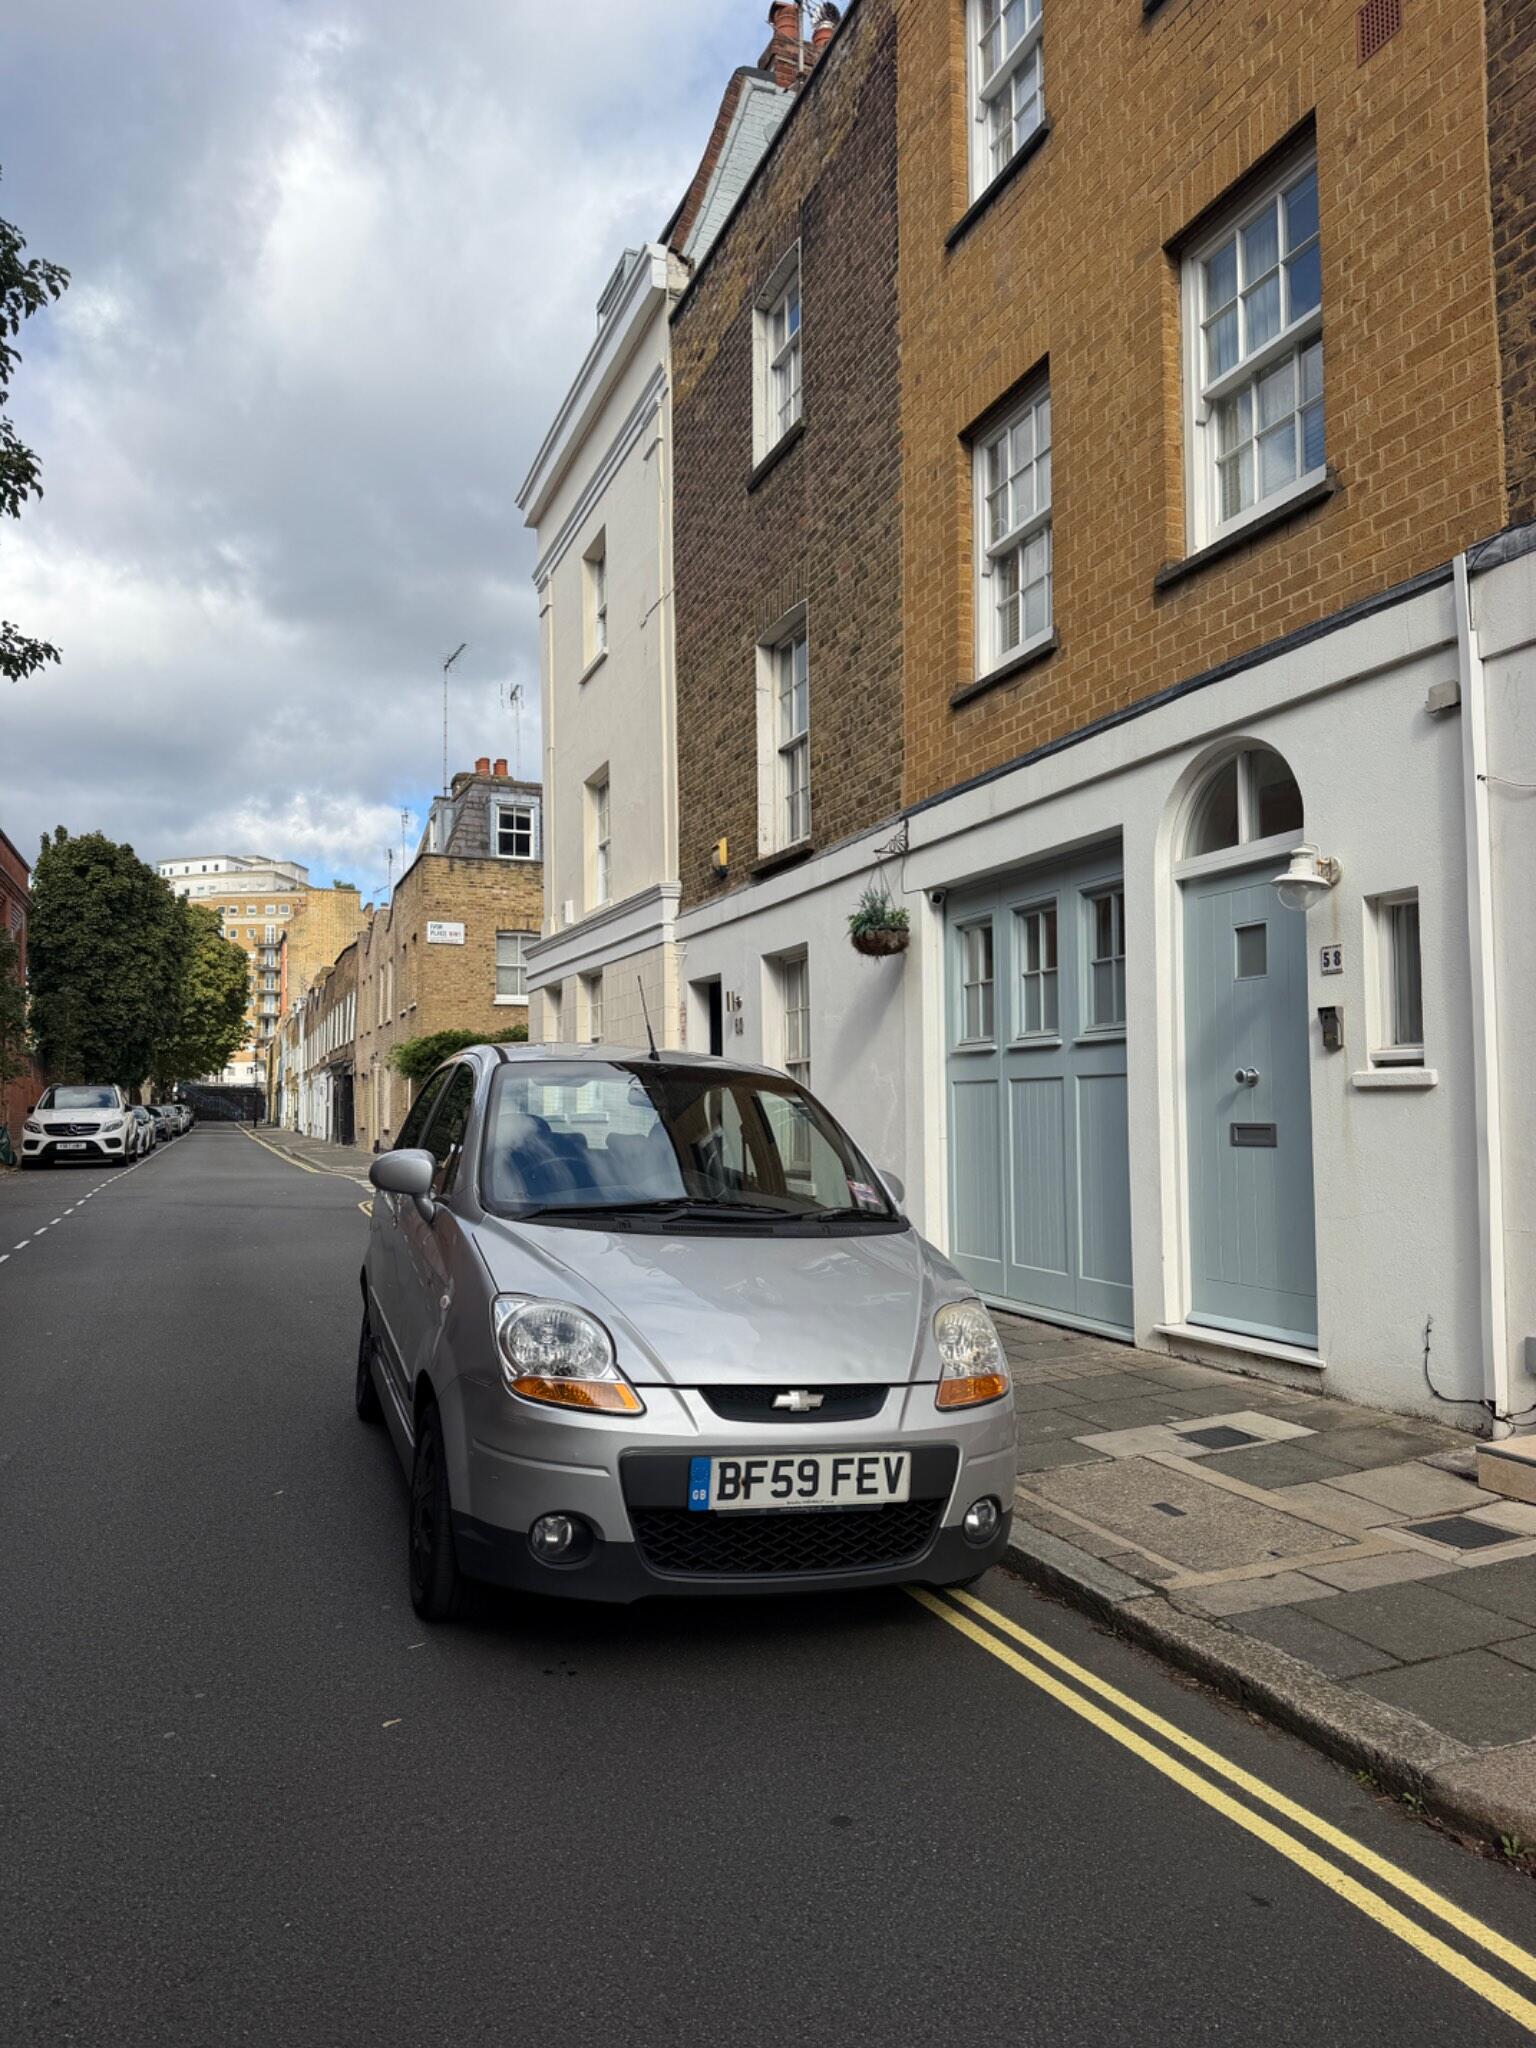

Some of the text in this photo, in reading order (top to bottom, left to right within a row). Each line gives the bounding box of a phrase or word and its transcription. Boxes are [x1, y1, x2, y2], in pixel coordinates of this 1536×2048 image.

[1323, 951, 1342, 968] 58
[717, 1456, 904, 1500] BF59 FEV
[692, 1489, 706, 1500] GB
